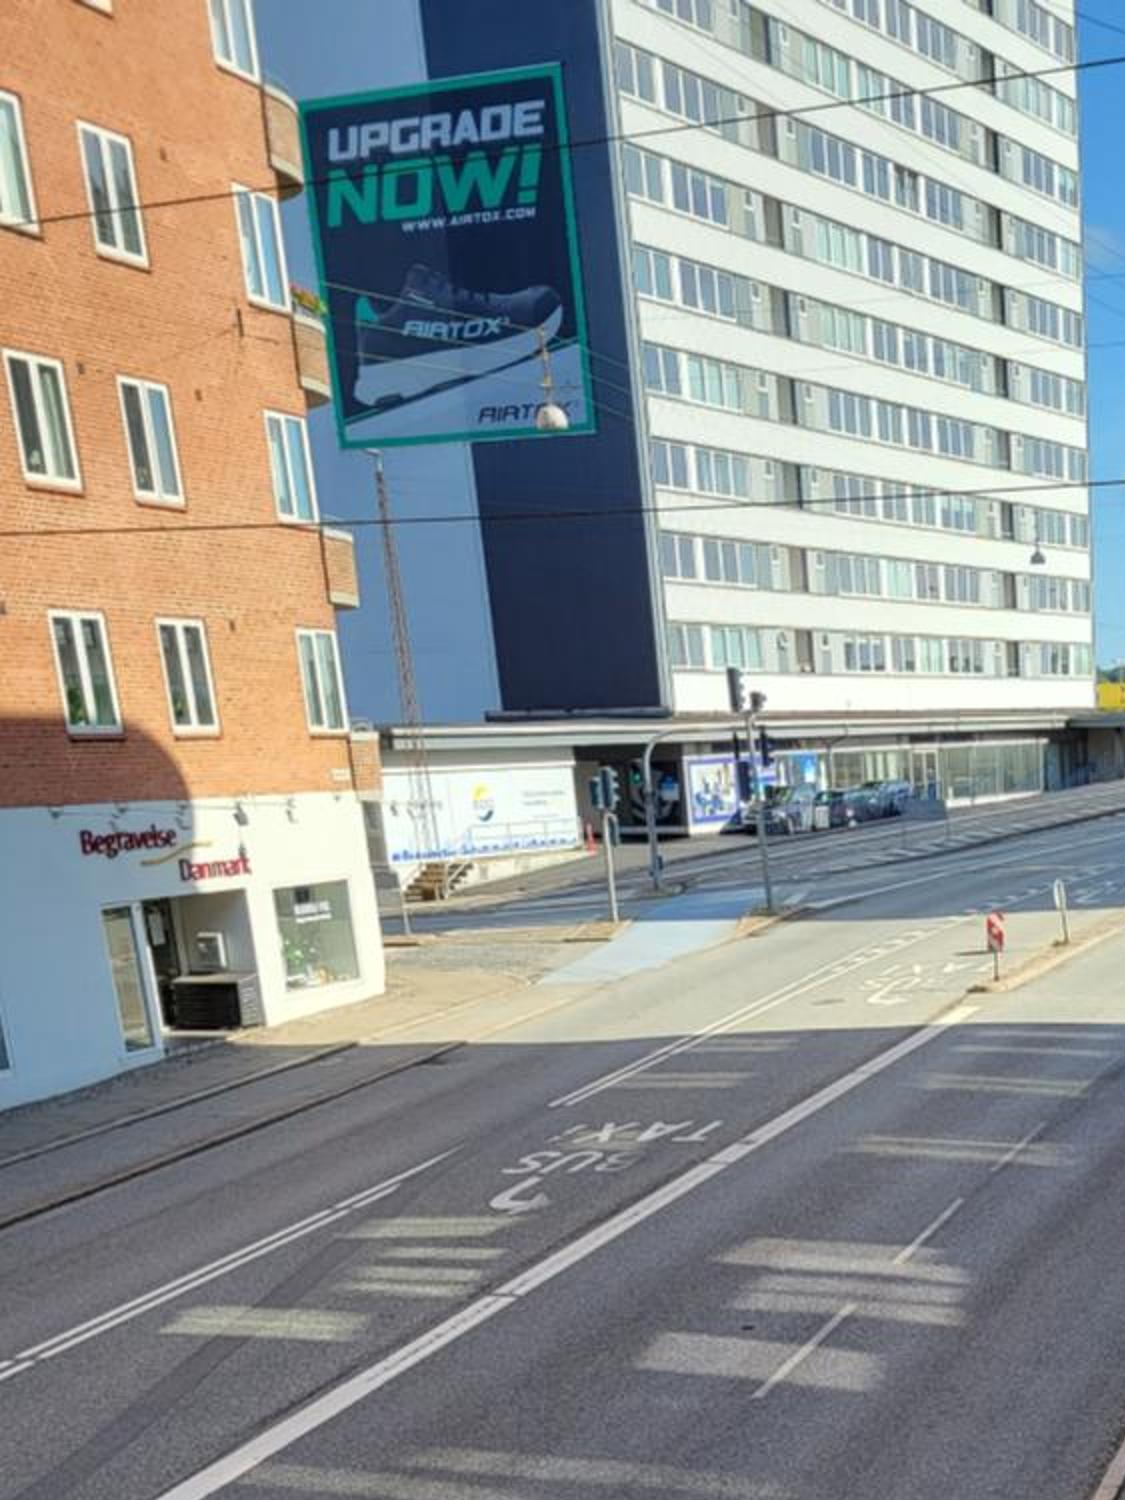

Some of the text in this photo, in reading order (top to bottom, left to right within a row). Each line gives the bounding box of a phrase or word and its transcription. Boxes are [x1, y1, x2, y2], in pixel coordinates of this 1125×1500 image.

[327, 100, 545, 163] UPGRADE
[326, 144, 543, 228] NOW!
[401, 207, 537, 232] WWW.AIRTOX.COM
[403, 317, 501, 341] AIRTOX
[79, 825, 178, 860] Begravelse
[178, 856, 252, 882] Danmark
[500, 1149, 645, 1175] BUS
